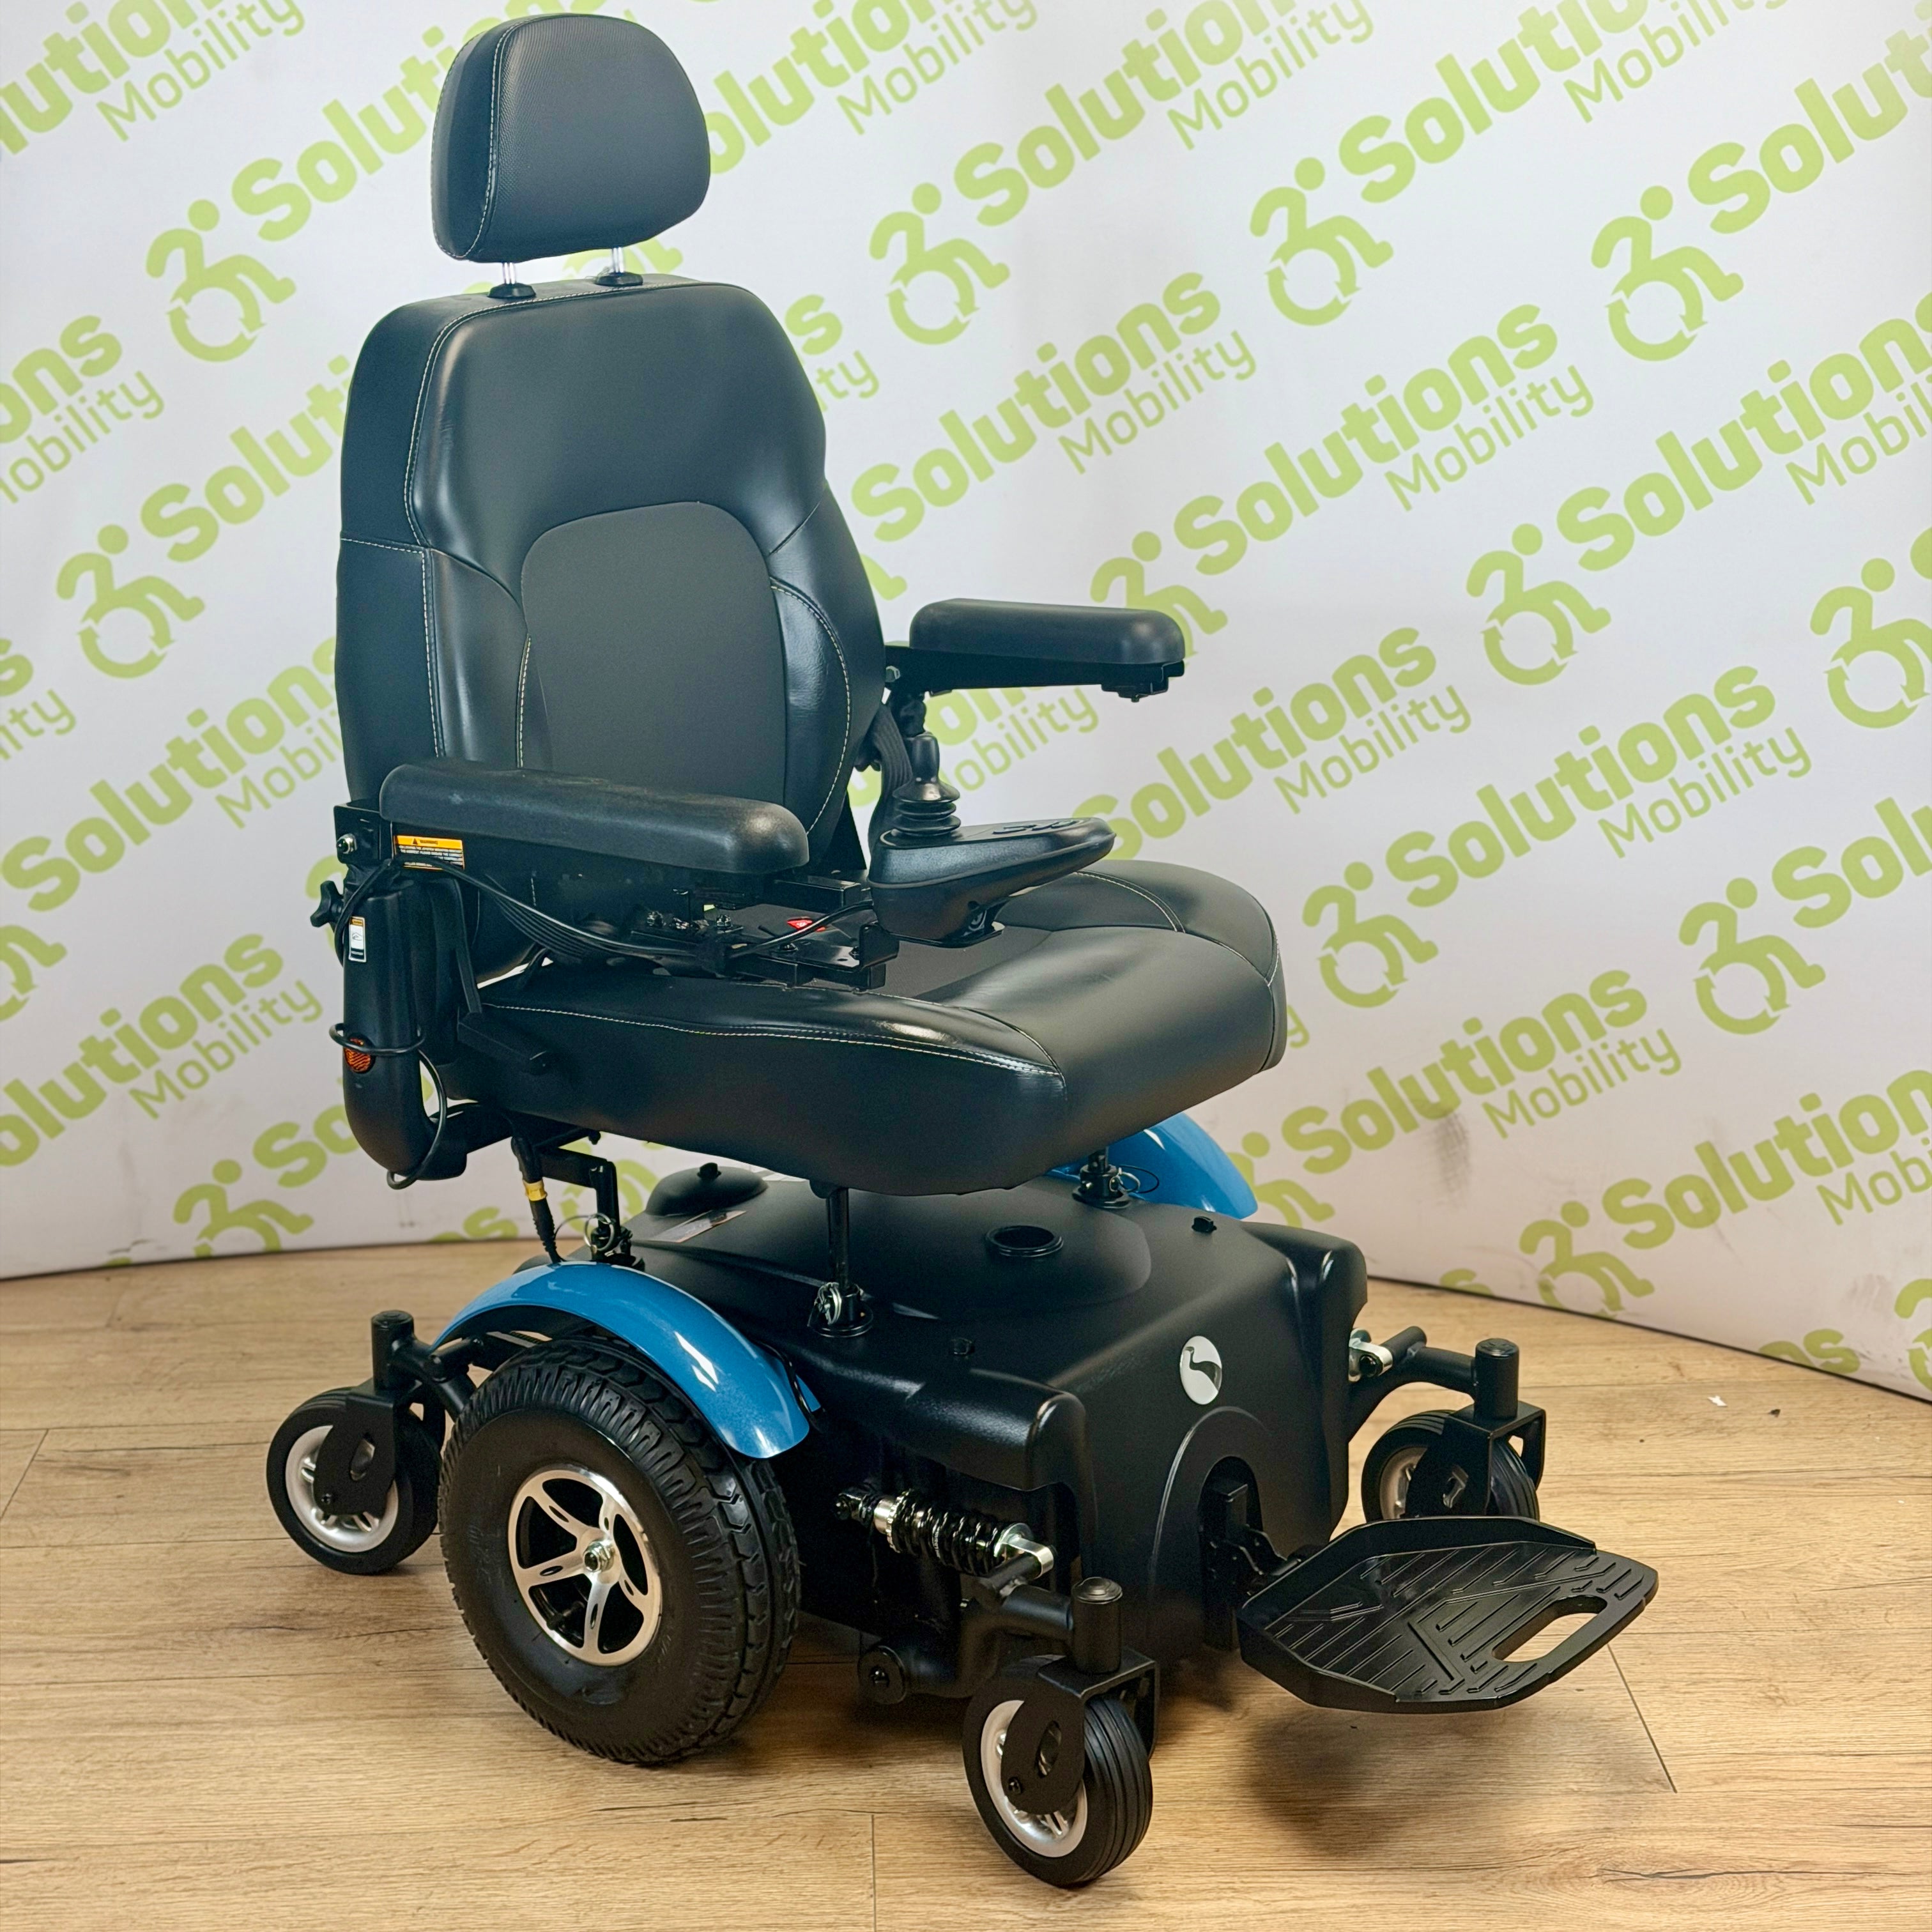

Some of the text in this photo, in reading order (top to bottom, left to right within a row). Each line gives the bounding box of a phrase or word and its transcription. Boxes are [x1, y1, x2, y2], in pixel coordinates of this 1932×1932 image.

[96, 0, 304, 141] Mobility
[836, 0, 1036, 135] Mobility
[1167, 0, 1373, 150] Mobility
[0, 371, 164, 503] obility
[851, 272, 1220, 542] Solutions
[1058, 332, 1256, 474] Mobility
[1174, 304, 1558, 576] Solutions
[1384, 365, 1593, 511] Mobility
[1556, 291, 1932, 571] Solution
[937, 688, 1098, 791] obility
[1273, 686, 1471, 814] Mobility
[1385, 666, 1775, 908] Solutions
[1598, 728, 1811, 859] Mobility
[128, 981, 323, 1120] Mobility
[1282, 970, 1647, 1174] Solutions
[1482, 1029, 1682, 1138] Mobility
